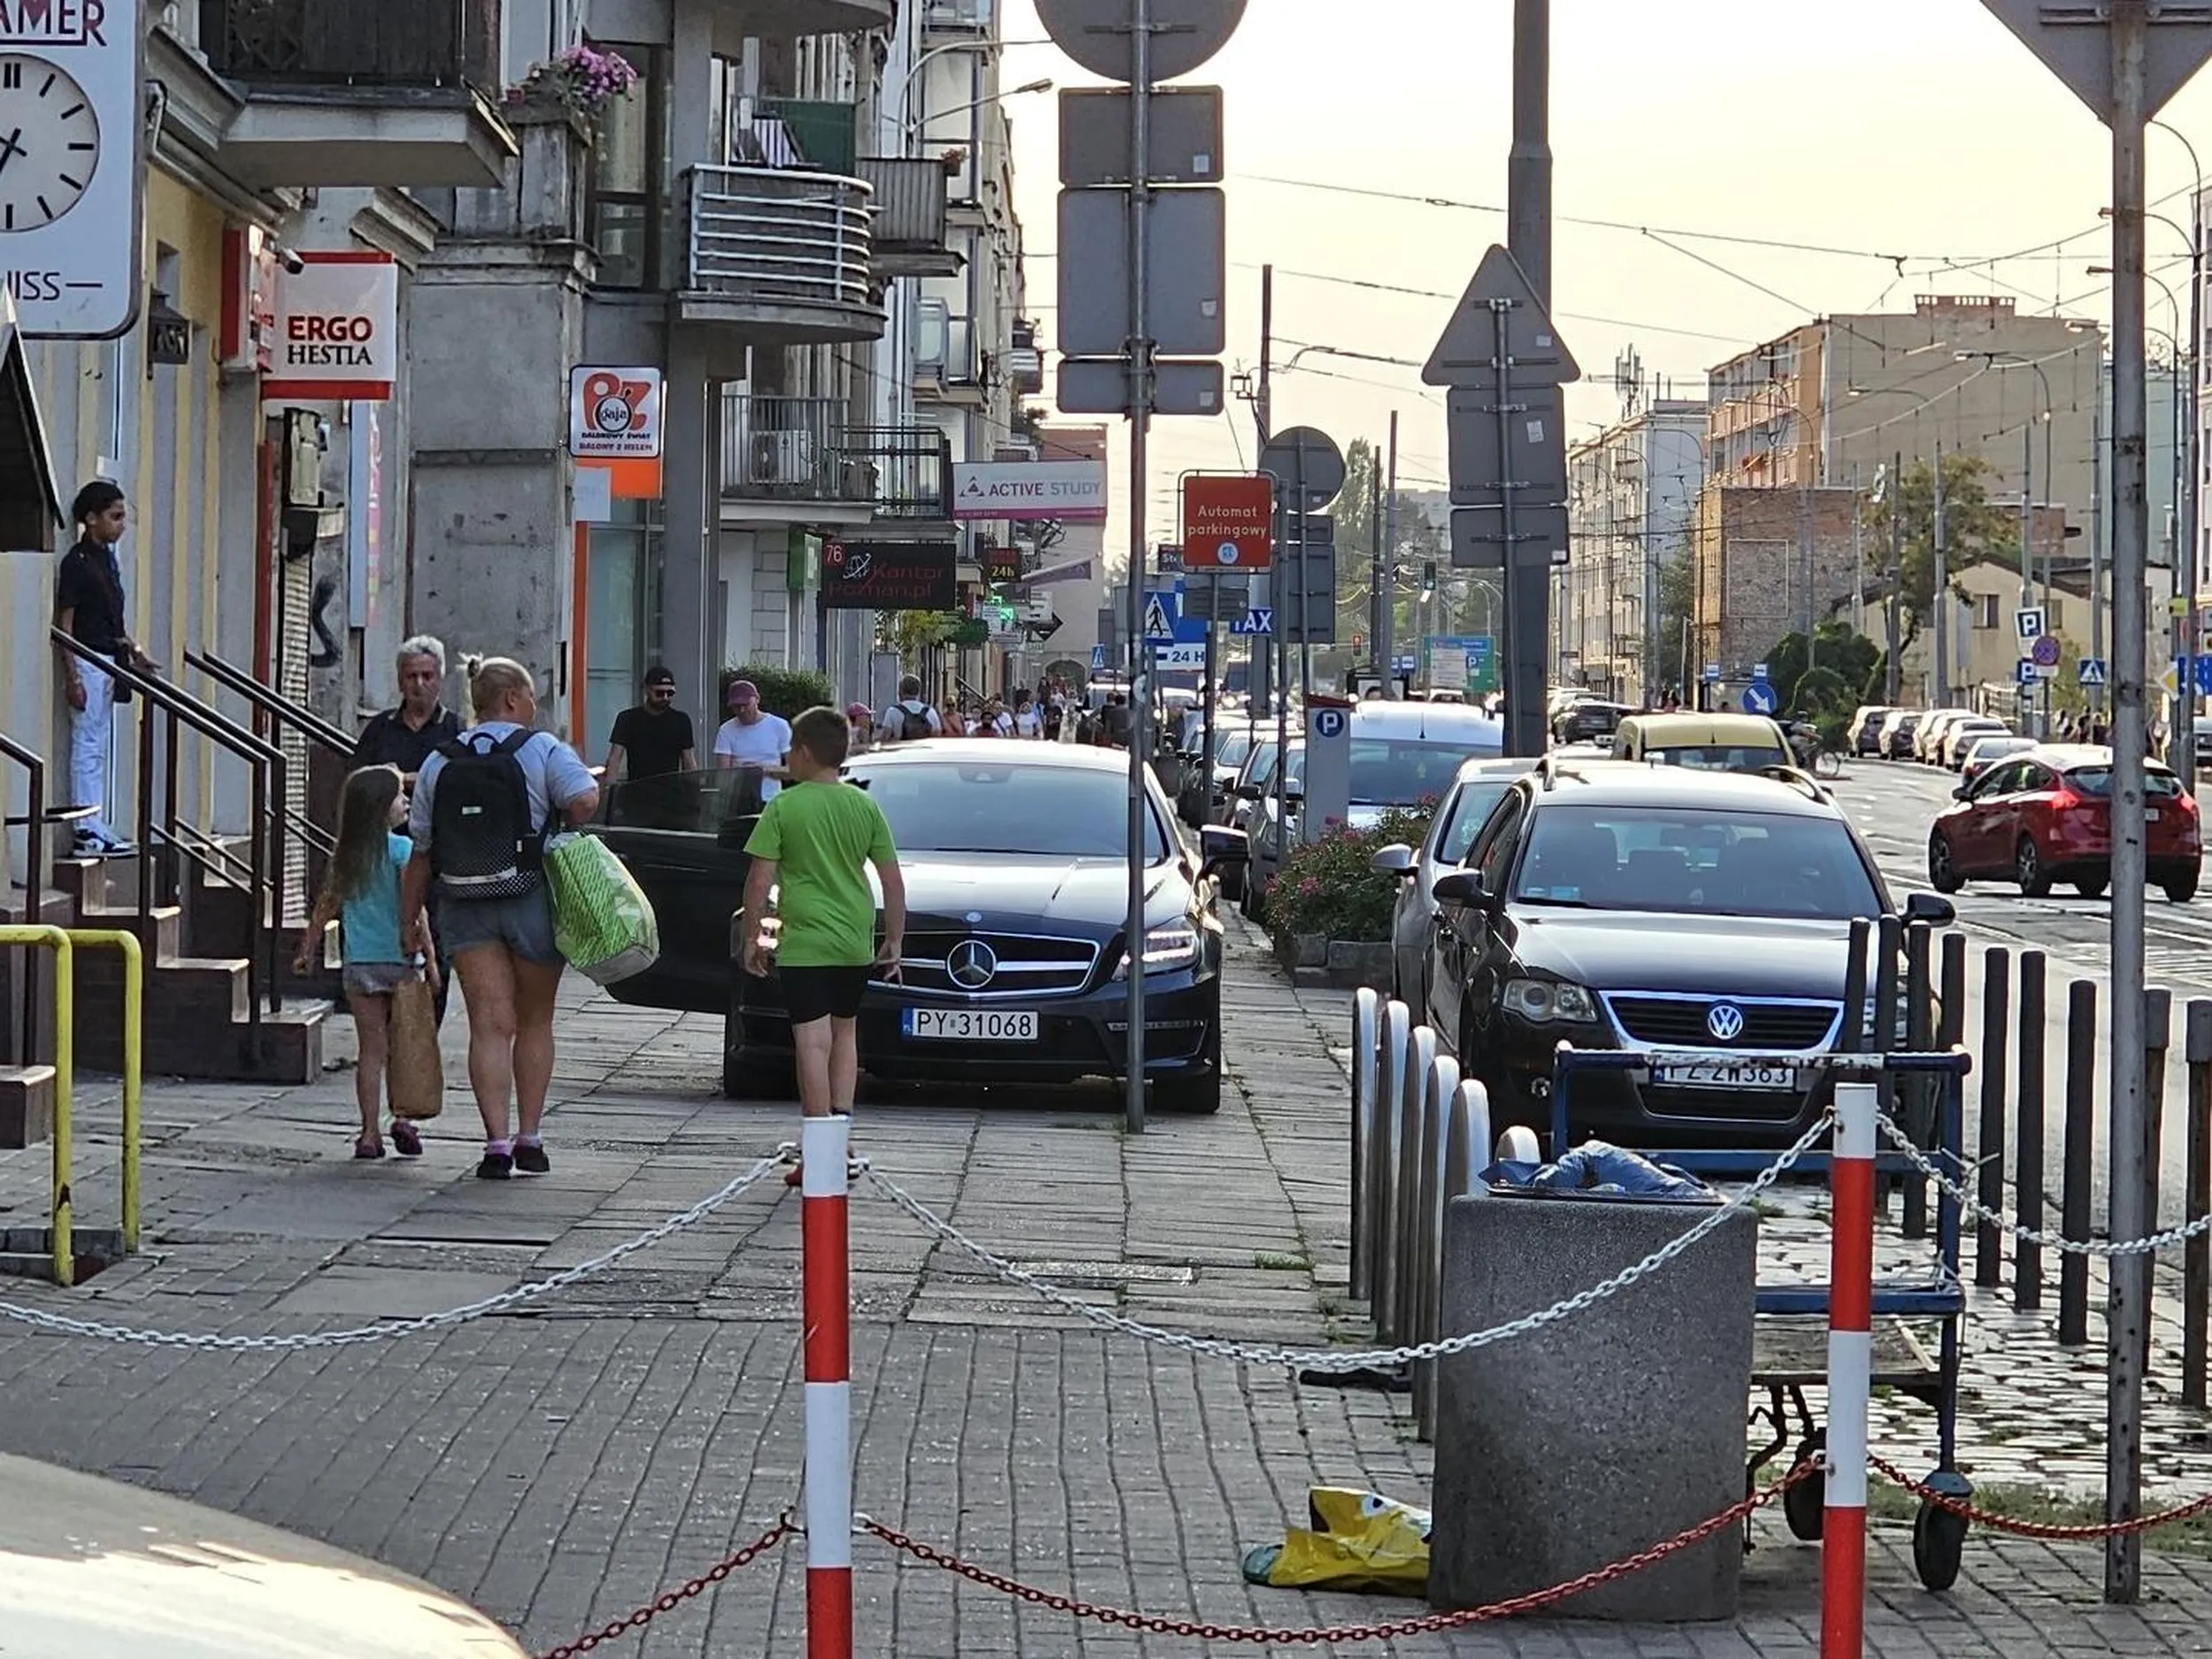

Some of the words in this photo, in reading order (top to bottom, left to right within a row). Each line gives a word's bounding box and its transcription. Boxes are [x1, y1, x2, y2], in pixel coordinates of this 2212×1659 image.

[288, 316, 373, 342] ERGO
[288, 344, 373, 365] HESTIA
[989, 482, 1044, 496] ACTIVE
[1051, 481, 1101, 495] STUDY
[1197, 504, 1257, 517] Automat
[1187, 524, 1267, 539] parkingowy
[826, 544, 842, 563] 76
[872, 565, 943, 580] Kantor
[2023, 614, 2037, 635] P
[1171, 651, 1190, 662] 24
[2021, 663, 2036, 682] P
[1322, 713, 1339, 733] P
[918, 1011, 948, 1035] PY
[958, 1013, 1031, 1037] 31068
